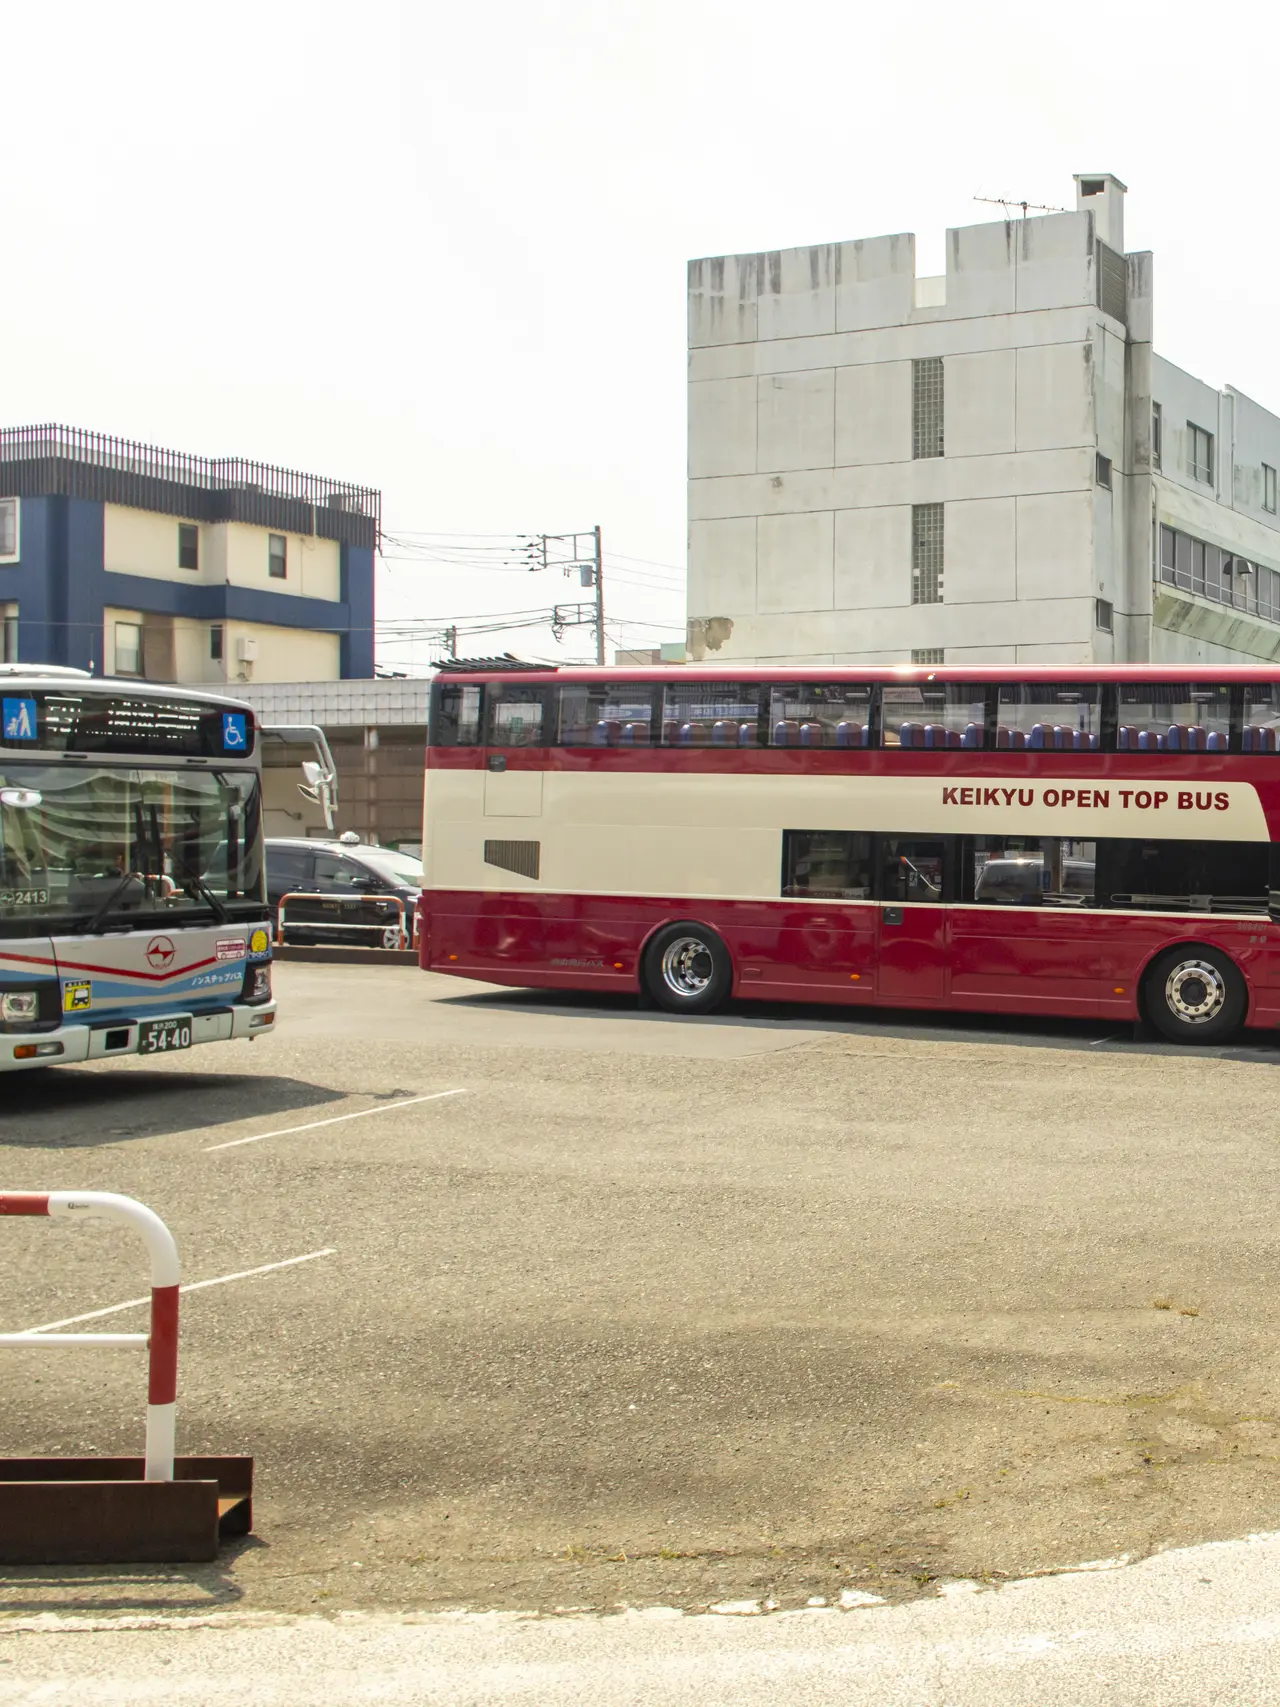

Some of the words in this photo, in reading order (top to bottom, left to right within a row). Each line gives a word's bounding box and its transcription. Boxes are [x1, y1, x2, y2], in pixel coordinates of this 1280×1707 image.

[942, 787, 1034, 806] KEIKYU
[1043, 789, 1110, 808] OPEN
[1118, 790, 1168, 809] TOP
[1177, 791, 1230, 811] BUS
[15, 891, 47, 904] 2413
[191, 971, 243, 986] ノンステップバス
[148, 1027, 190, 1052] 54-40
